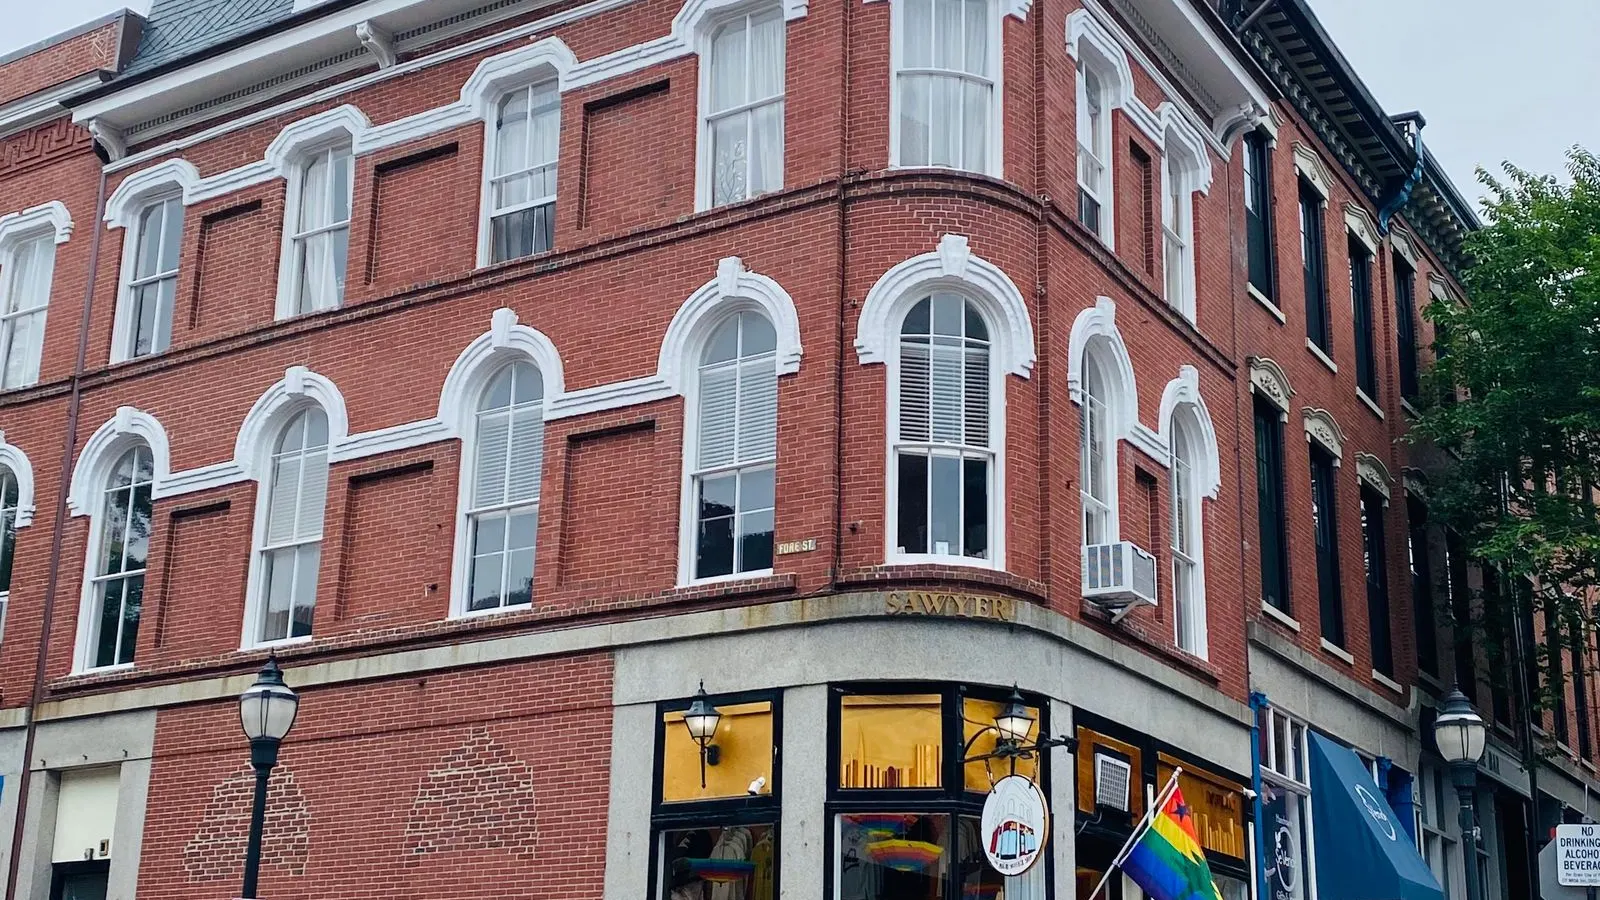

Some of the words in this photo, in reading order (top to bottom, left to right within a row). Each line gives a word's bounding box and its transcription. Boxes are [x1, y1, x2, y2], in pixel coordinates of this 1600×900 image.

[778, 541, 800, 555] FORE
[885, 591, 1009, 620] SAWYER
[1581, 826, 1594, 837] NO
[1560, 837, 1600, 848] DRINKING
